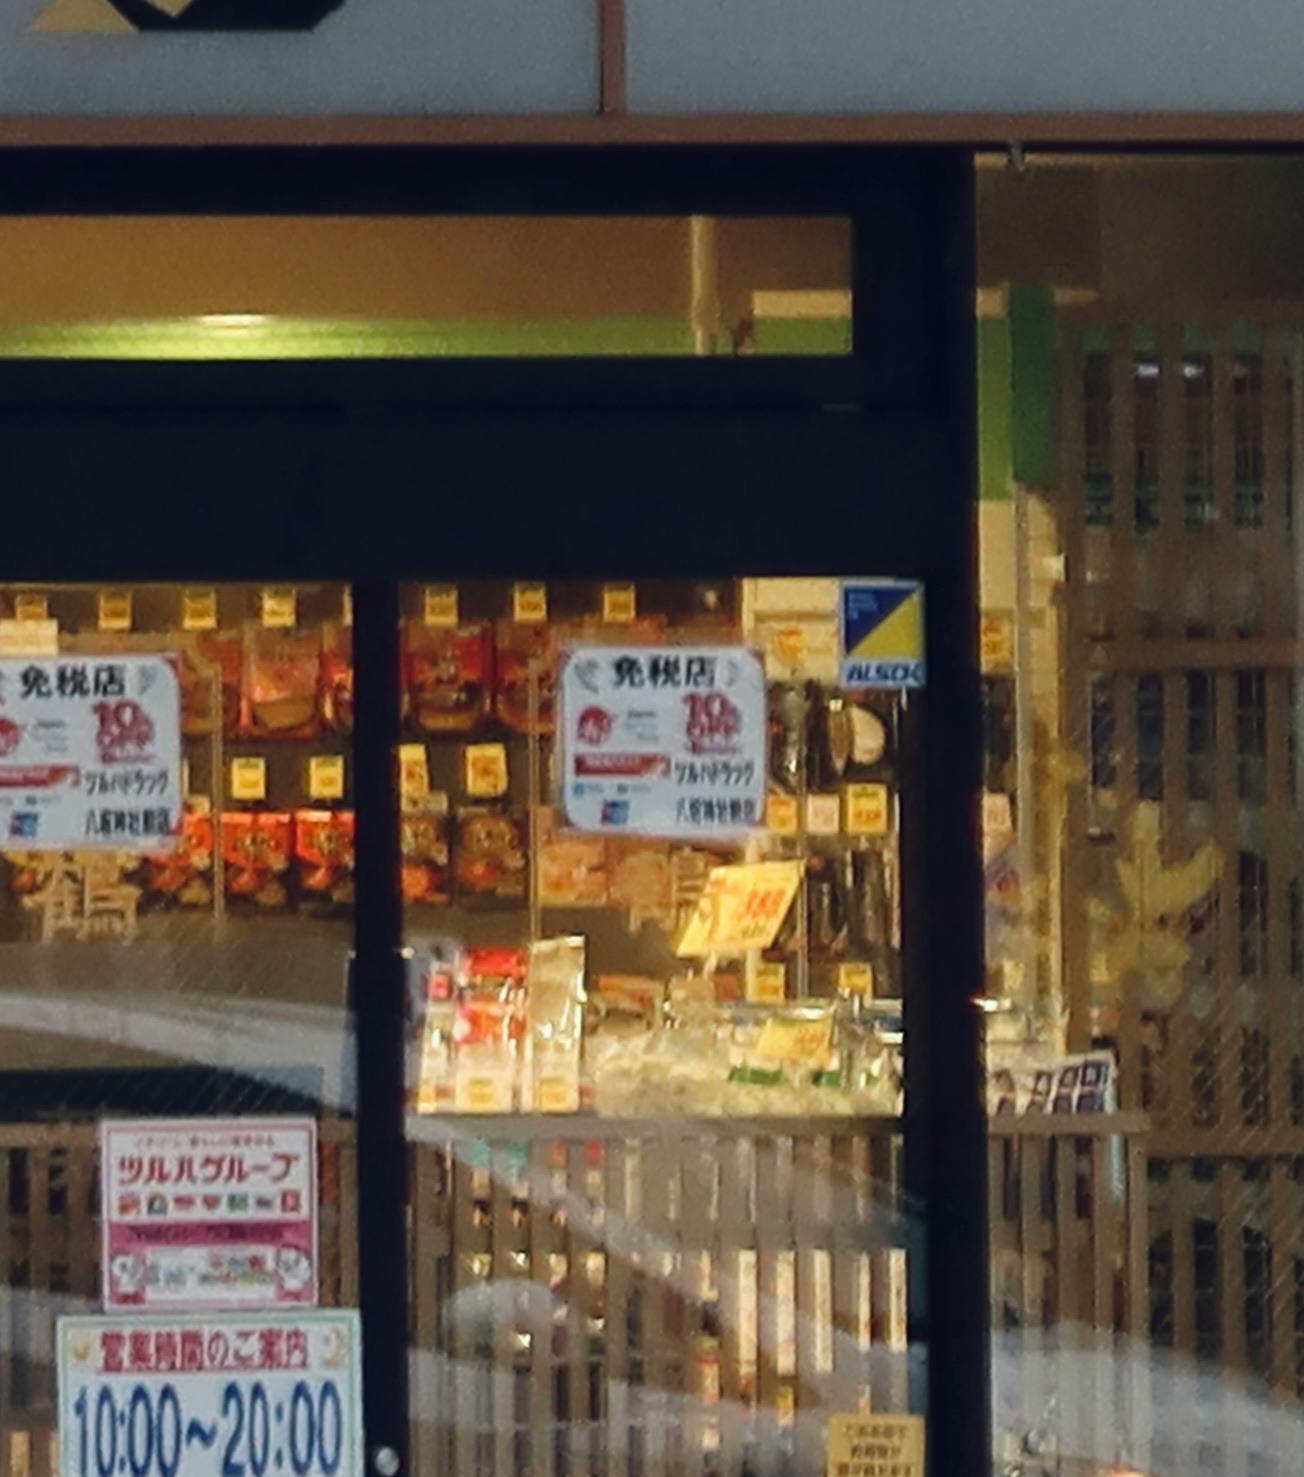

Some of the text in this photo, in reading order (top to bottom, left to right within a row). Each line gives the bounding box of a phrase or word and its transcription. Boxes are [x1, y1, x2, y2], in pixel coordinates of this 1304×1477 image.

[20, 665, 126, 698] 免税店
[614, 656, 718, 689] 免税店
[118, 1152, 300, 1185] ツルハグループ
[100, 1327, 309, 1373] 営業時間のご案内
